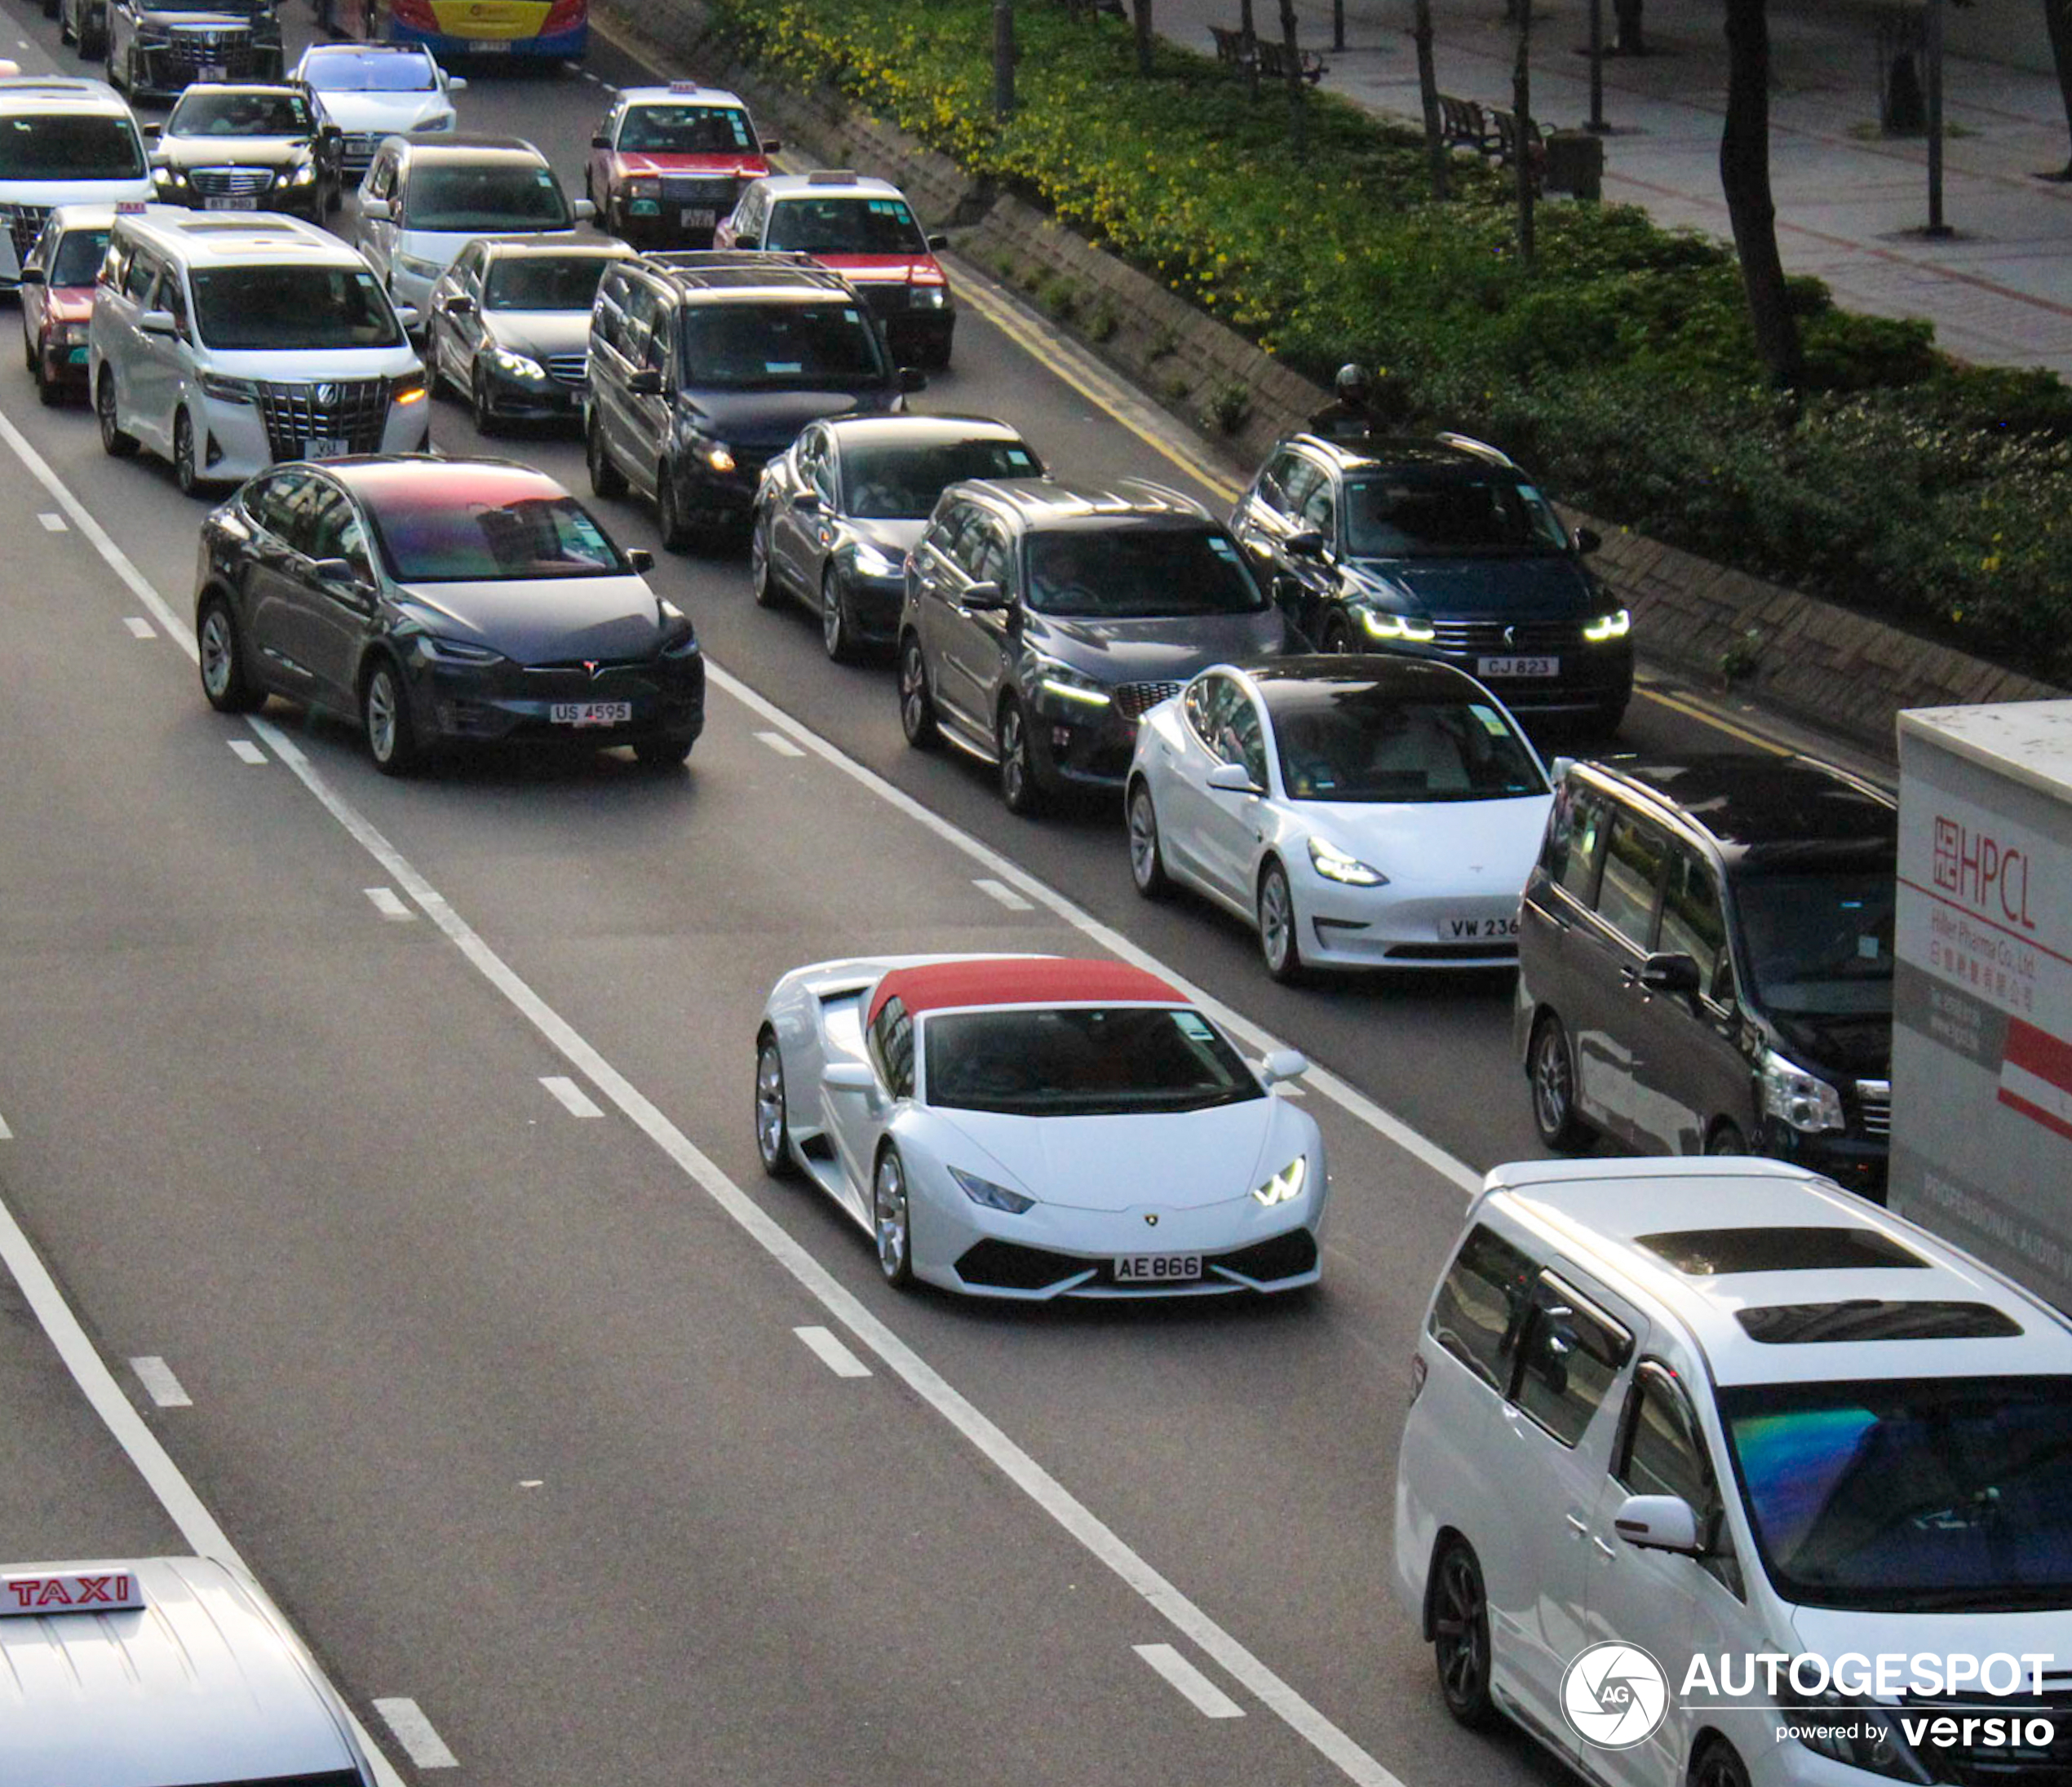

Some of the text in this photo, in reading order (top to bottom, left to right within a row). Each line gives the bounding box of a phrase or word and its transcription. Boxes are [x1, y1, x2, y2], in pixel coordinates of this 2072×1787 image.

[1489, 661, 1549, 674] CJ 823
[556, 705, 626, 720] US 4595
[1960, 827, 2035, 930] HPCL
[1451, 920, 1478, 936] VW
[9, 1576, 129, 1607] TAXI
